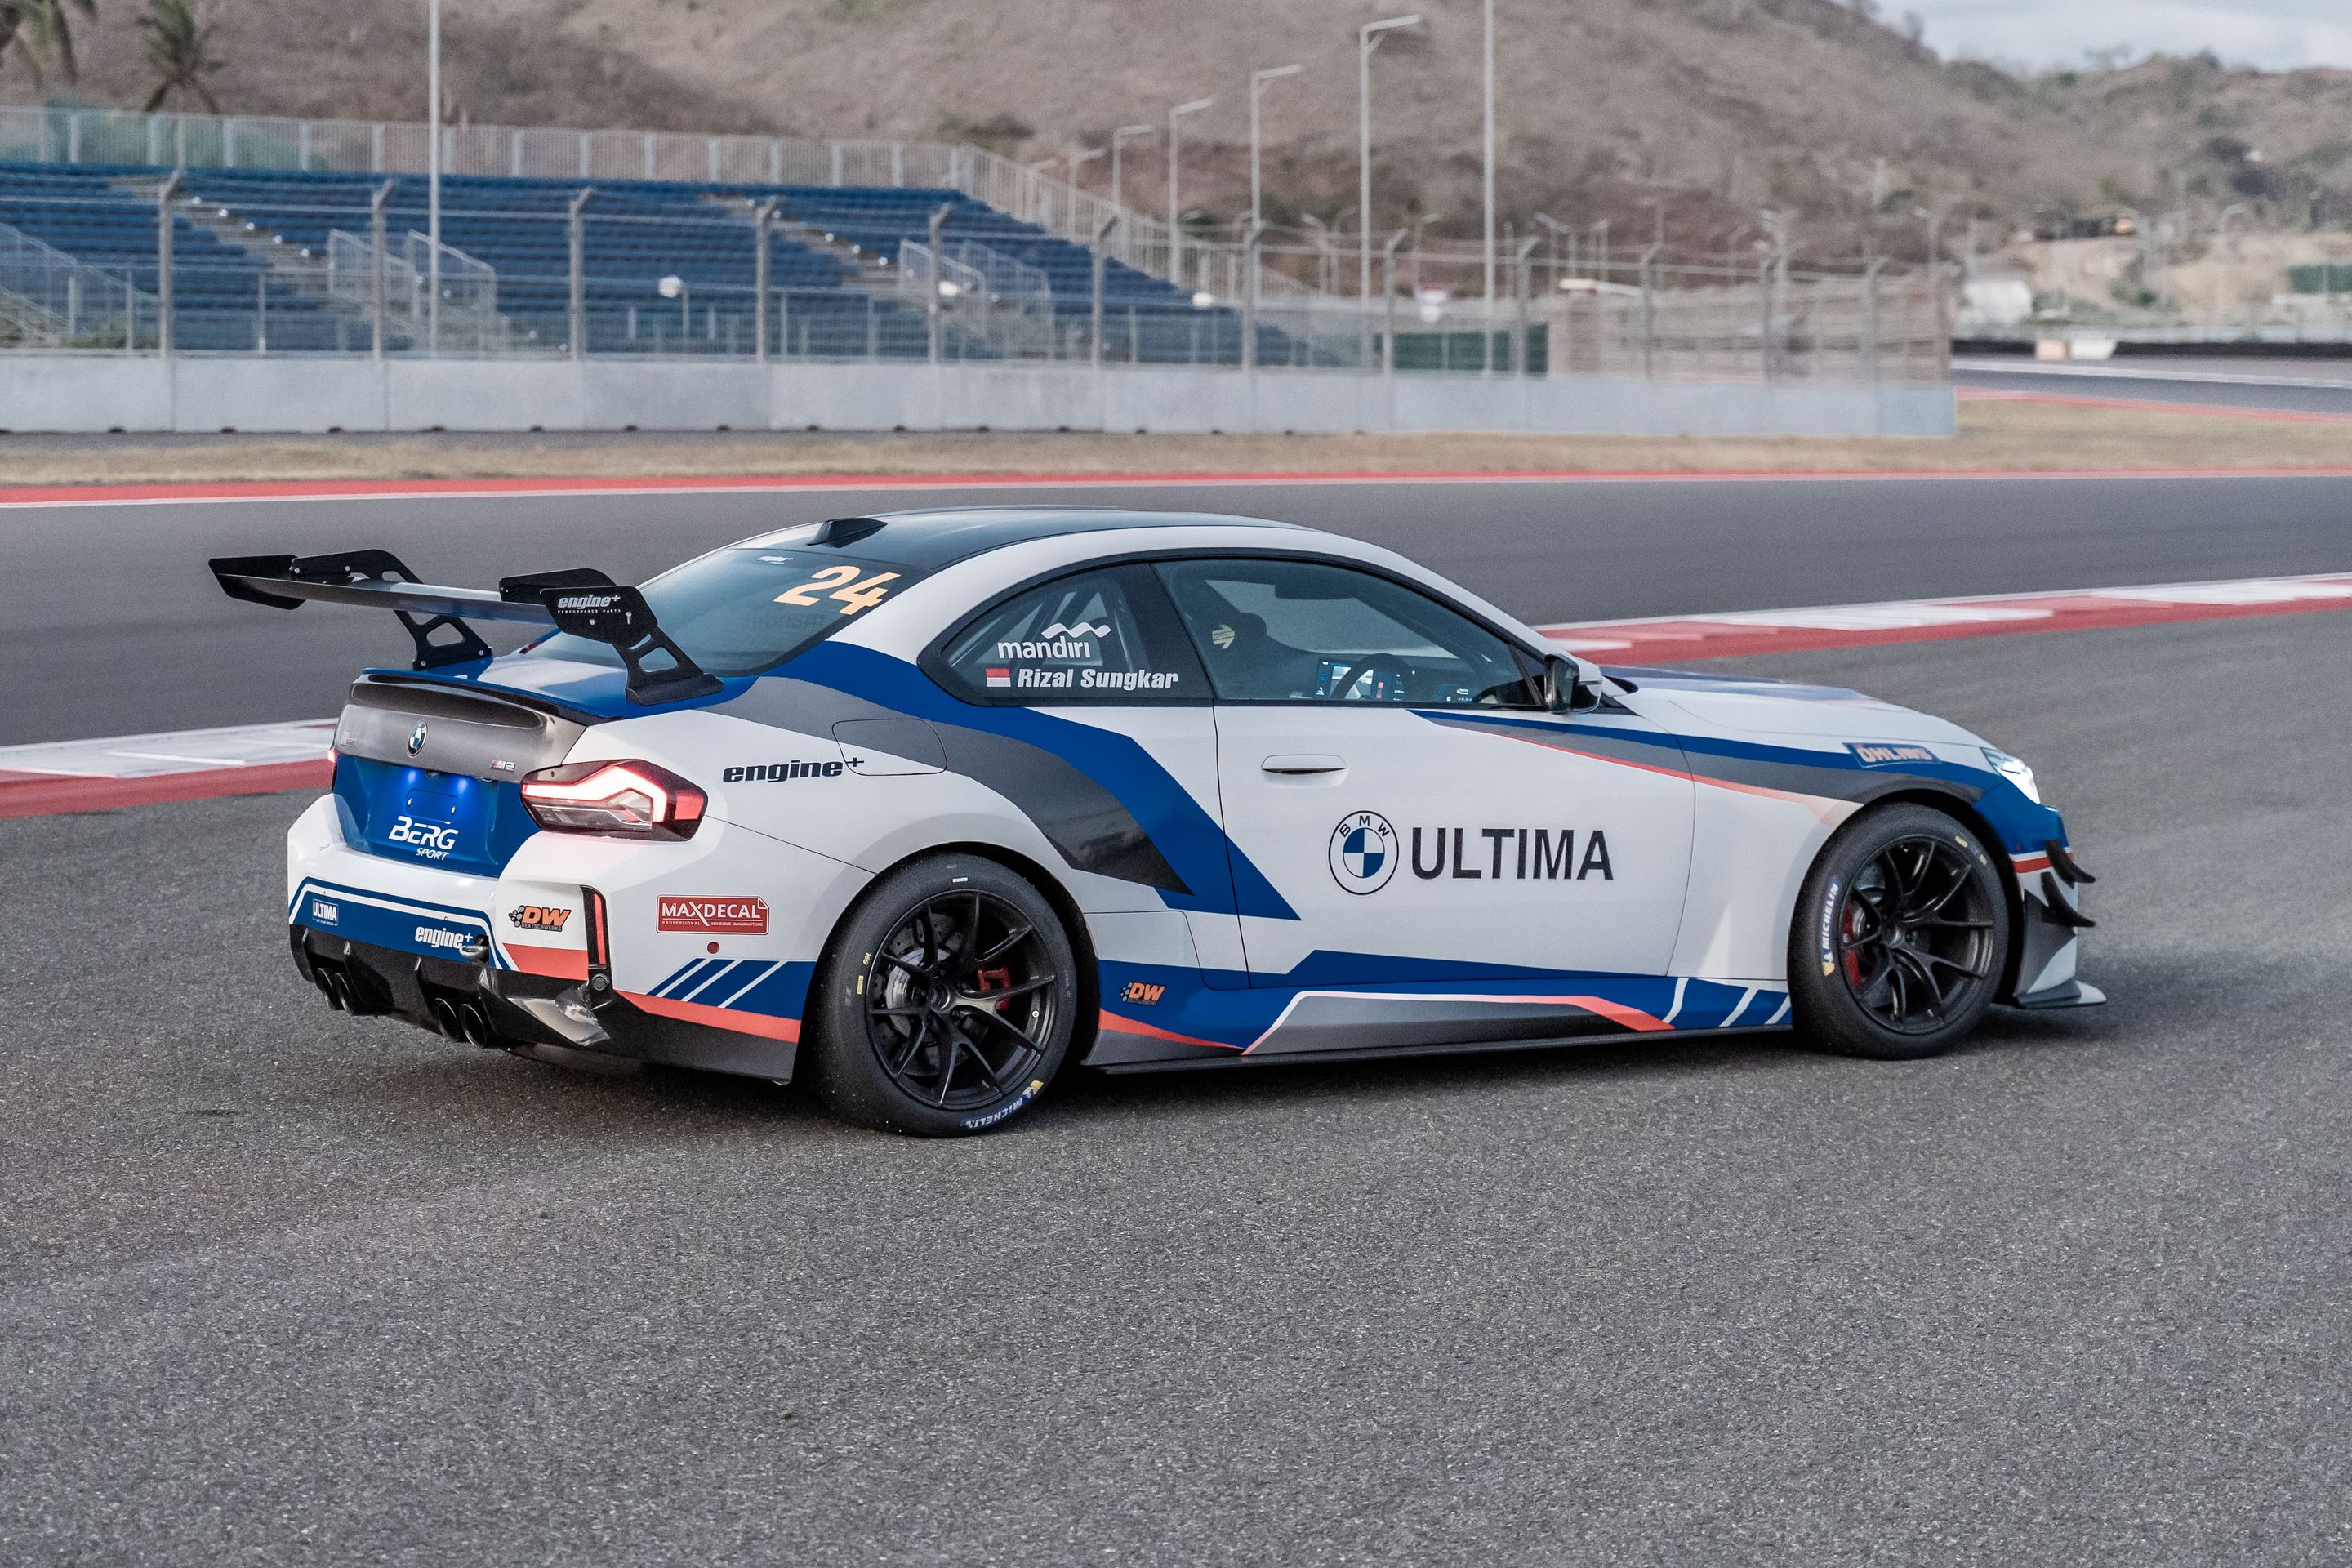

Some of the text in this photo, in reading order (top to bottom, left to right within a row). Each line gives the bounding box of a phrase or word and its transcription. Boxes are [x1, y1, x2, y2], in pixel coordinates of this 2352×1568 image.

[773, 565, 901, 615] 24
[997, 636, 1091, 659] mandiri
[1018, 668, 1178, 691] Rizal Sungkar
[388, 815, 459, 850] BERG
[416, 847, 449, 861] SPORT
[1339, 815, 1614, 880] BMW ULTIMA
[313, 901, 338, 922] ULTIMA
[521, 905, 572, 927] DW
[662, 902, 761, 926] MAXDECAL
[1822, 883, 1839, 951] MICHELIN
[1128, 982, 1166, 1001] DW
